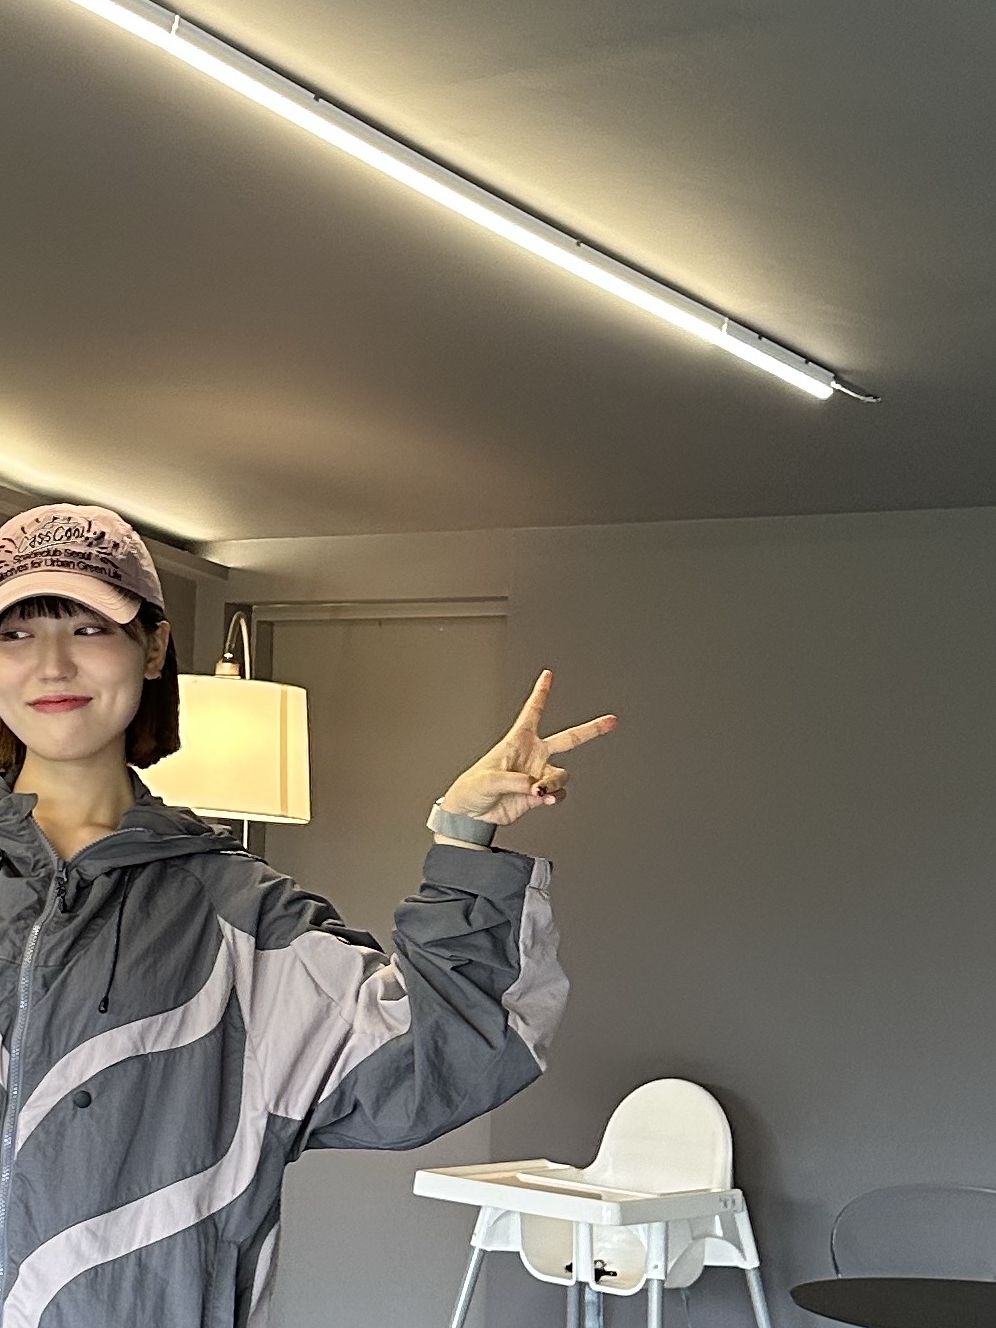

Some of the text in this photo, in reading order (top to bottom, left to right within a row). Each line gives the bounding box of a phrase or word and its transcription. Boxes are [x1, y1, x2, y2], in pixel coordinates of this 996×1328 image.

[31, 559, 43, 569] for
[45, 558, 75, 570] Urban
[77, 560, 108, 576] Green
